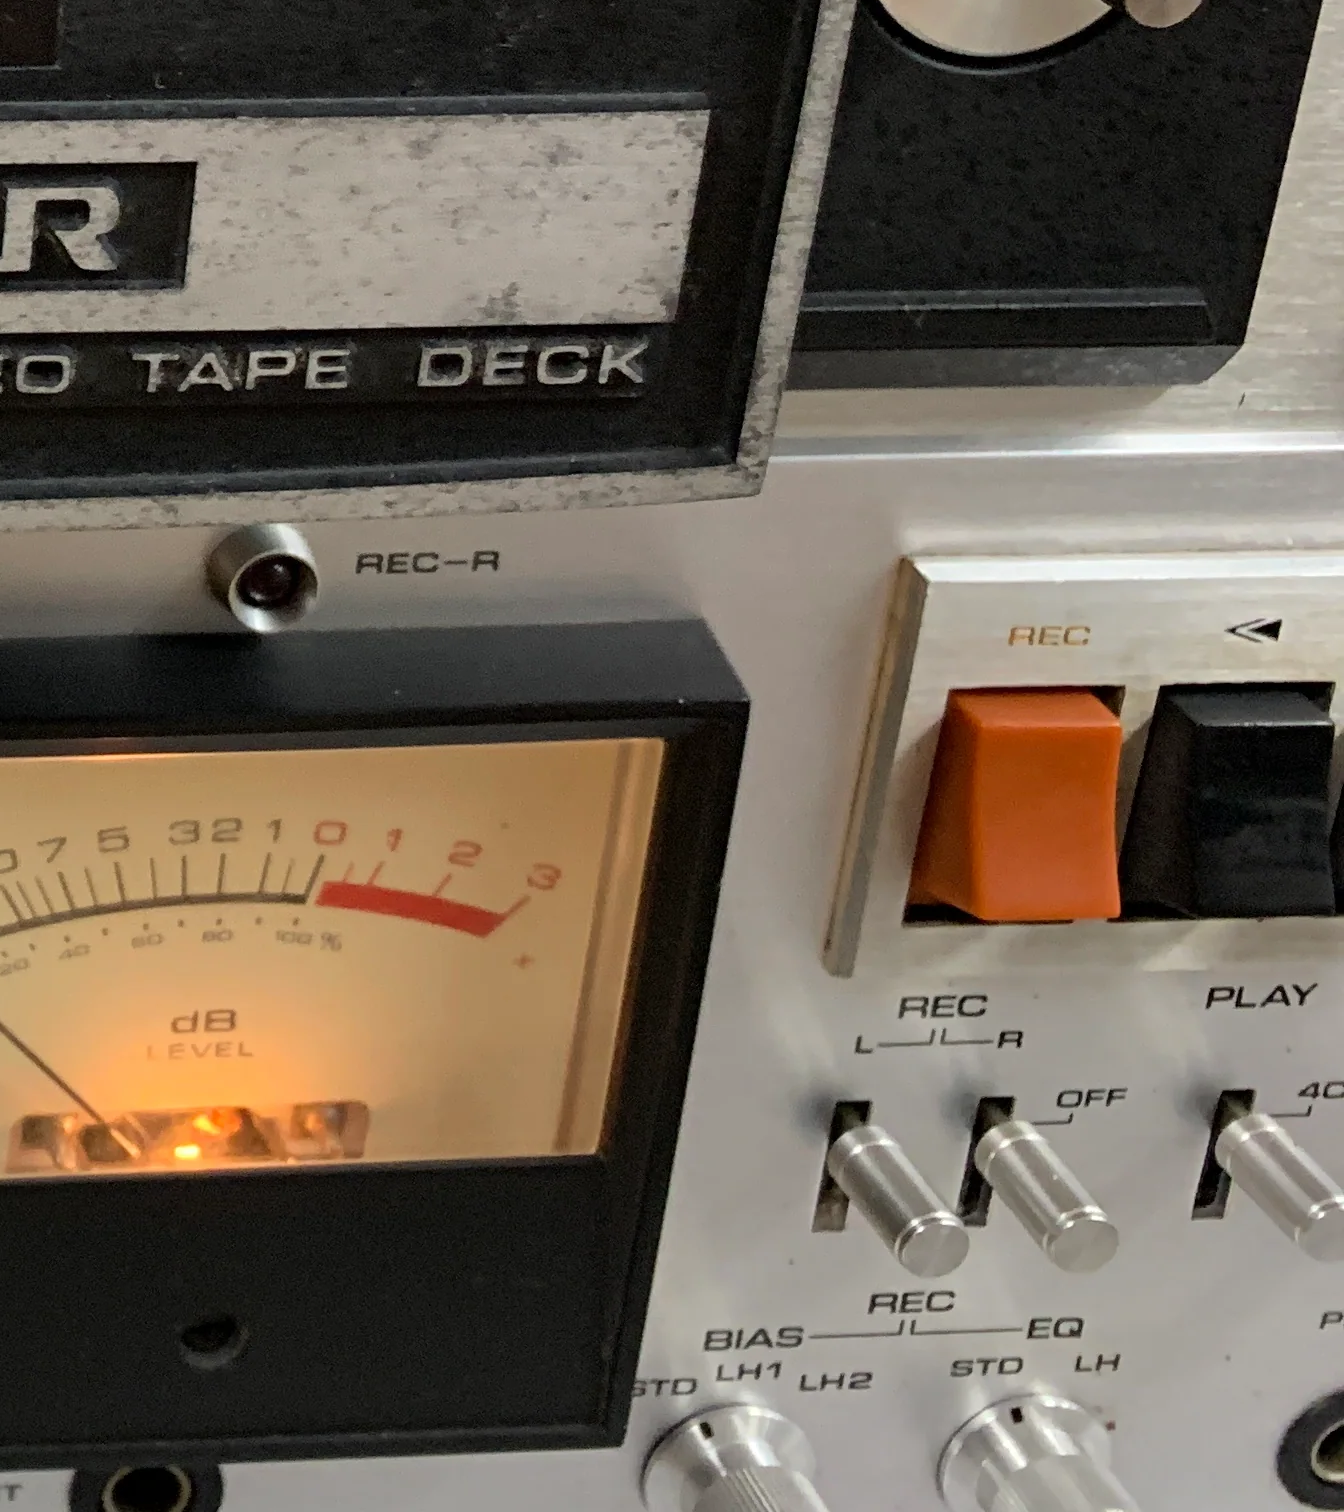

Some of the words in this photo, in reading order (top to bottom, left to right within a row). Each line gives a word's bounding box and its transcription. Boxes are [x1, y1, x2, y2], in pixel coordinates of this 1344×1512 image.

[132, 347, 350, 394] TAPE
[415, 342, 648, 388] DECK
[355, 551, 501, 575] REC-R
[1007, 625, 1092, 647] REC
[36, 836, 68, 864] 7
[97, 826, 131, 853] 5
[168, 820, 202, 846] 3
[209, 817, 243, 844] 2
[263, 819, 284, 843] 1
[314, 820, 348, 847] 0
[447, 839, 484, 868] 2
[527, 863, 563, 891] 3
[897, 995, 989, 1019] REC
[1205, 984, 1317, 1010] PLAY
[170, 1009, 237, 1033] dB
[147, 1042, 253, 1061] LEVEL
[854, 1036, 873, 1054] L
[997, 1031, 1024, 1049] R
[1056, 1088, 1128, 1109] OFF
[868, 1291, 957, 1316] REC
[703, 1326, 805, 1352] BIAS
[1025, 1317, 1085, 1340] EQ
[949, 1356, 1025, 1379] STD
[1073, 1353, 1121, 1374] LH
[632, 1377, 699, 1398] STD
[715, 1360, 783, 1382] LH1
[799, 1371, 874, 1392] LH2
